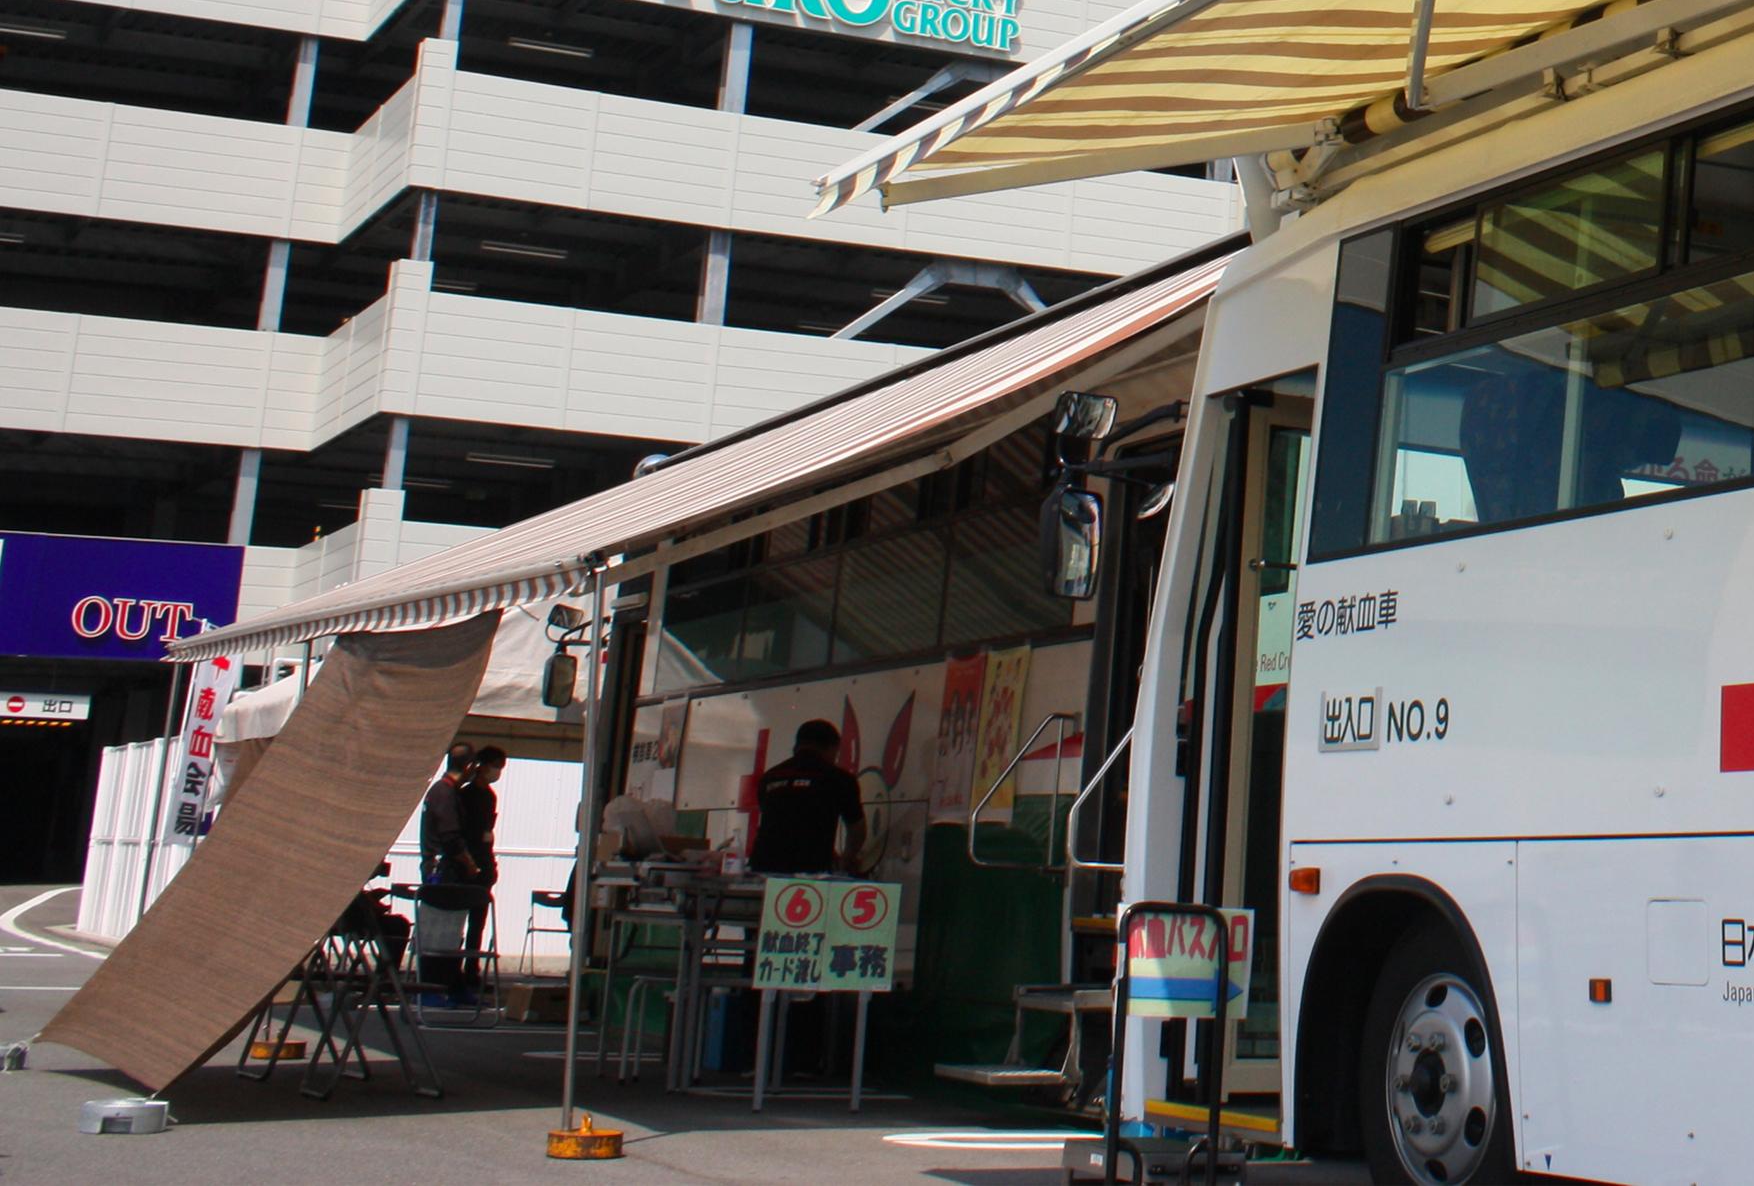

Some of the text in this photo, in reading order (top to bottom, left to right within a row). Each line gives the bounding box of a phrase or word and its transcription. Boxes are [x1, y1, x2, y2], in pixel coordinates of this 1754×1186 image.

[893, 0, 1021, 52] GROUP
[71, 595, 194, 643] OUT
[1296, 589, 1399, 642] 愛の献血車
[1260, 652, 1277, 672] Red
[42, 699, 74, 714] 出口
[1323, 695, 1375, 744] 出入口
[1387, 697, 1449, 743] NO.9
[829, 944, 889, 979] 事務
